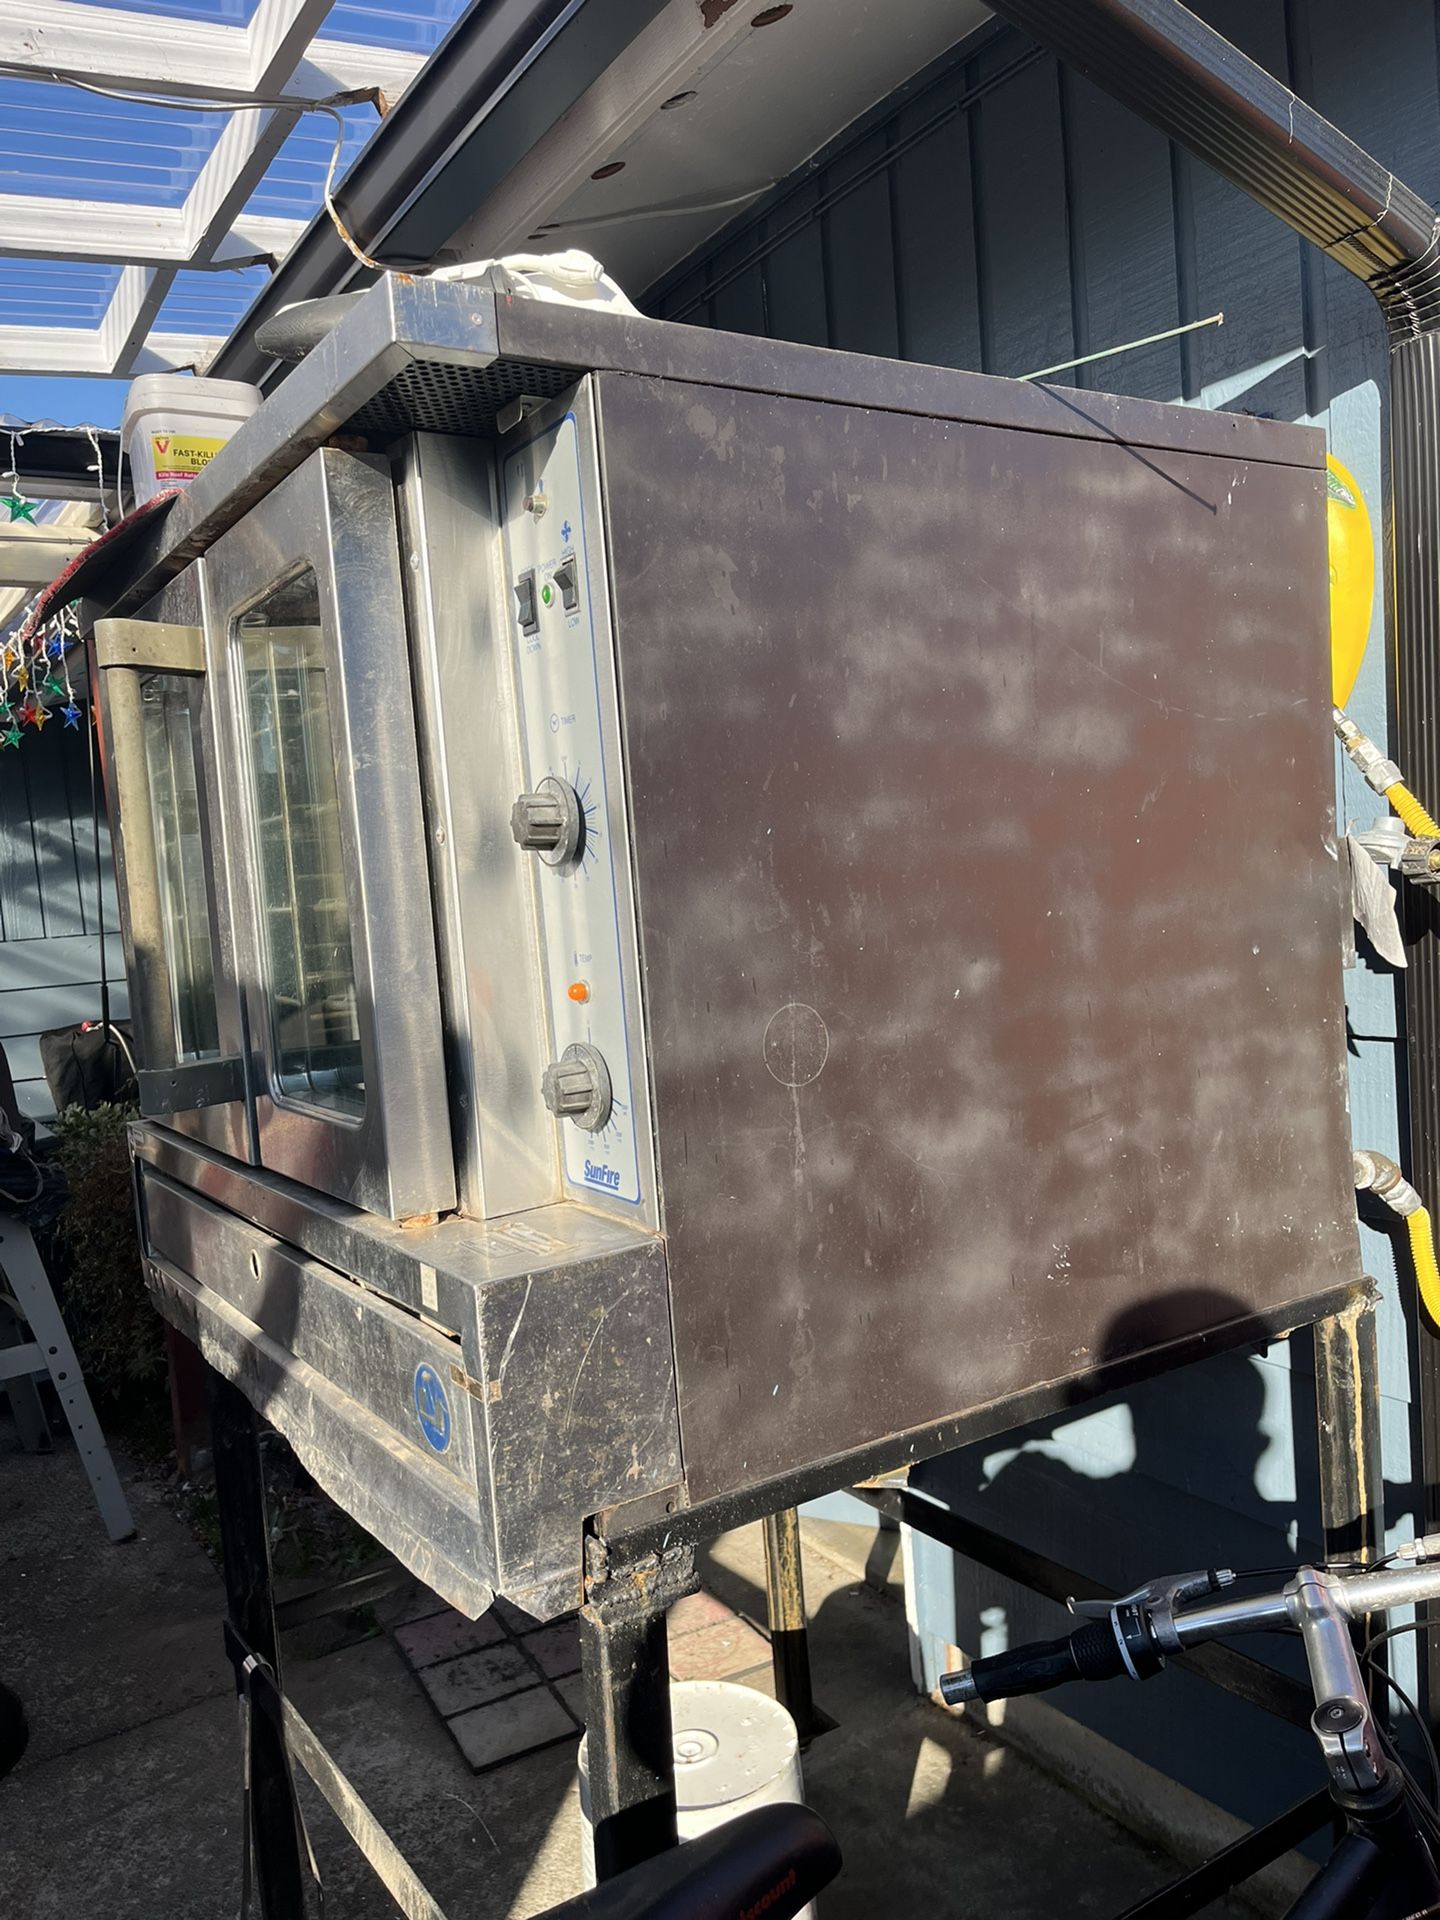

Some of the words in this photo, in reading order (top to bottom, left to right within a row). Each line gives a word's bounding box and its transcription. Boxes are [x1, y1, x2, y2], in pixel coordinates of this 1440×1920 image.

[155, 440, 170, 454] V
[190, 458, 210, 466] BLO
[567, 616, 580, 629] LOW
[584, 1159, 620, 1186] SunFire
